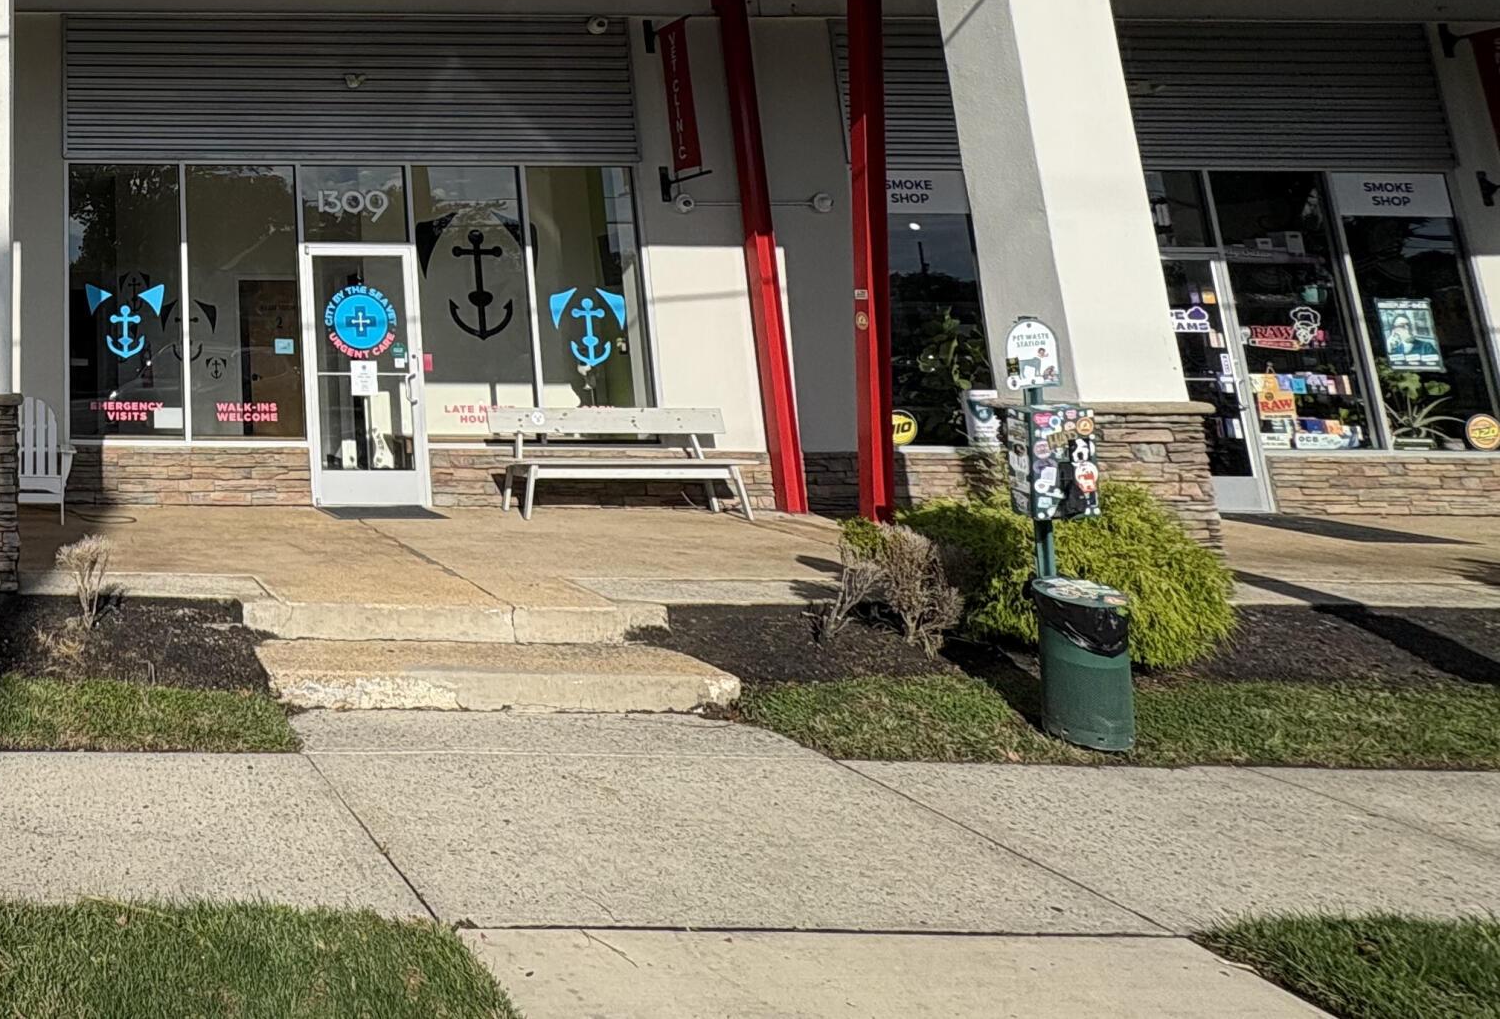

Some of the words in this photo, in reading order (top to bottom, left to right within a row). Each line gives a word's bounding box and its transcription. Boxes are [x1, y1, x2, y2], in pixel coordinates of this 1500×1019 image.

[672, 80, 687, 160] CLINIC
[885, 179, 933, 190] SMOKE
[1363, 182, 1414, 193] SMOKE
[891, 193, 929, 204] SHOP
[1372, 195, 1411, 206] SHOP
[317, 190, 389, 223] 1309
[324, 301, 335, 326] CITY
[333, 290, 346, 303] BY
[345, 285, 367, 295] THE
[369, 288, 388, 307] SEA
[385, 304, 397, 326] VET
[1251, 325, 1294, 340] RAW
[328, 332, 370, 359] URGENT
[372, 332, 395, 356] CARE
[90, 401, 164, 411] EMERGENCY
[216, 402, 277, 412] WALK-INS
[444, 404, 474, 413] LATE
[1260, 398, 1293, 412] RAW
[107, 412, 148, 421] VISITS
[217, 413, 278, 422] WELCOME
[460, 415, 485, 424] HOU
